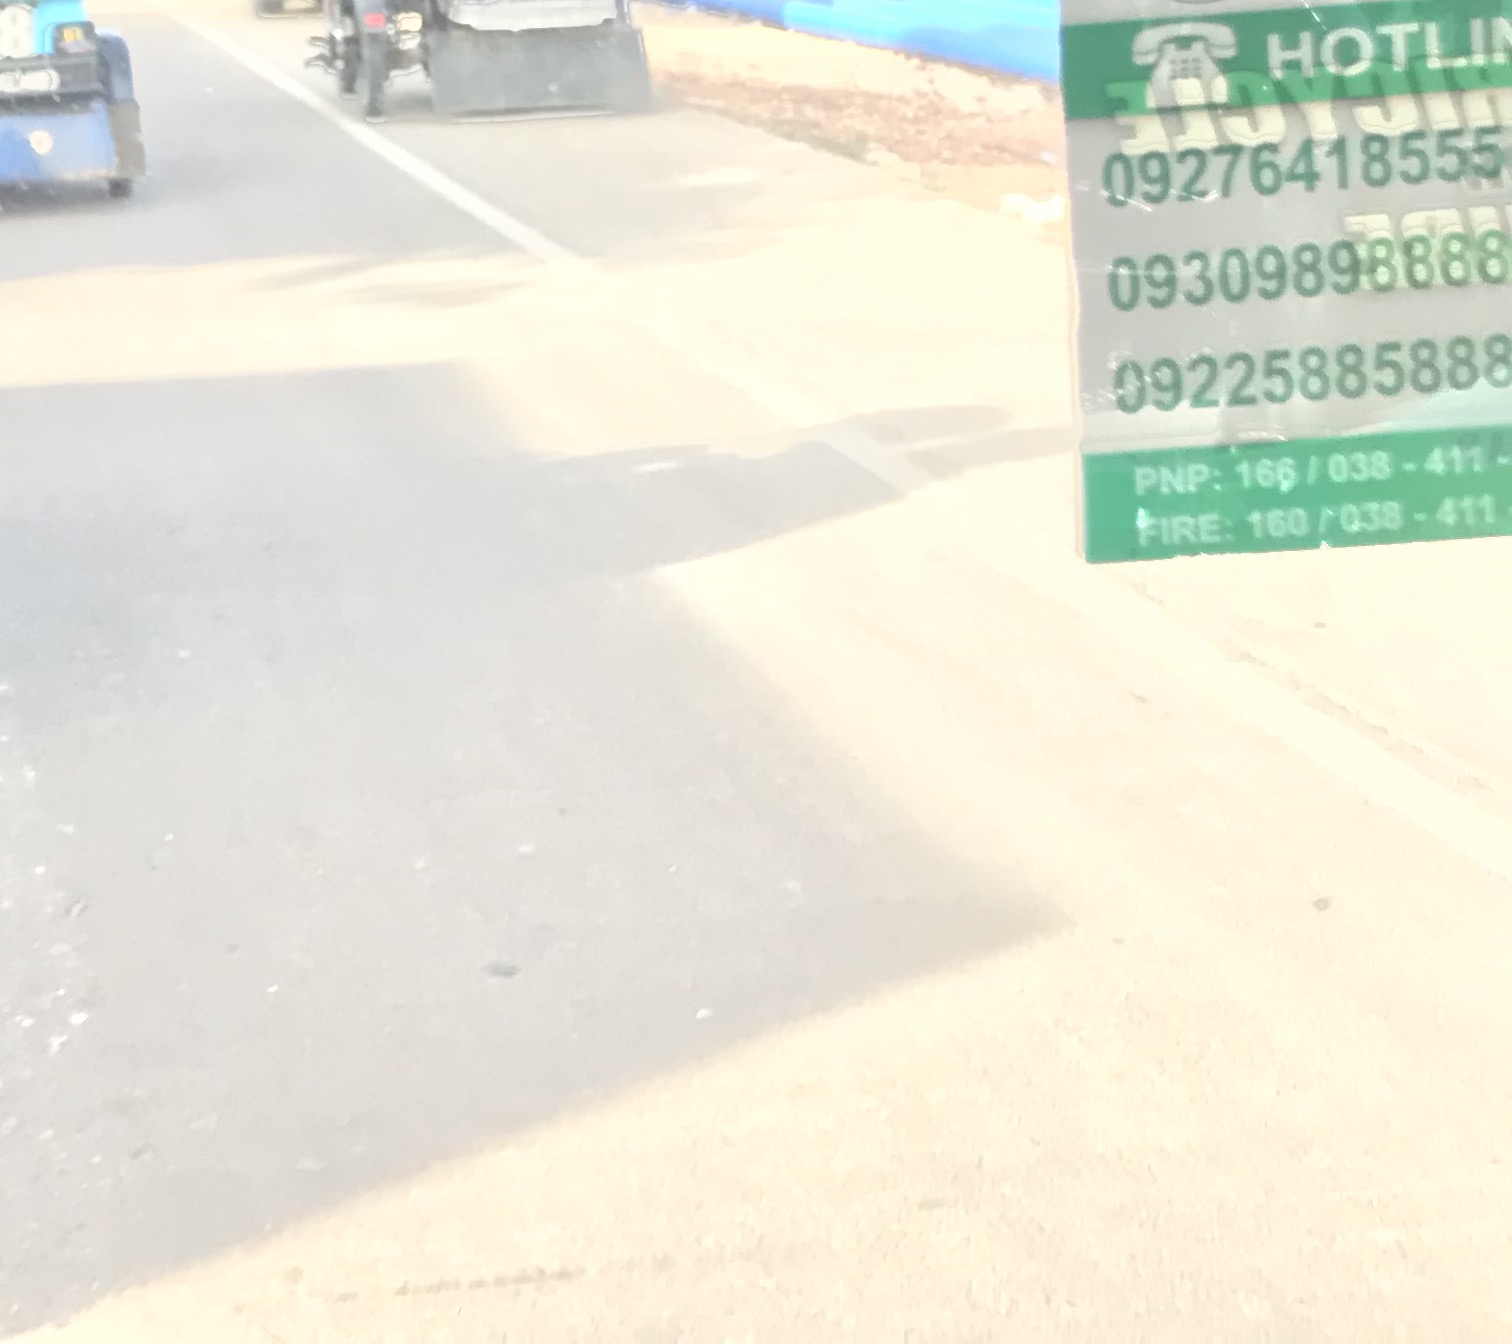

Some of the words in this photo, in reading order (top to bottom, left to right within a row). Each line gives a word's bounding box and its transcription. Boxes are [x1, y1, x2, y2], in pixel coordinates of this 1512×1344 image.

[1101, 125, 1508, 207] 09276418555
[1108, 229, 1511, 313] 09309898888
[1113, 333, 1512, 415] 09225885888
[1136, 462, 1222, 495] PNP:
[1307, 454, 1318, 486] /
[1326, 449, 1392, 484] 038
[1423, 445, 1486, 478] 411
[1138, 510, 1234, 547] FIRE:
[1248, 506, 1310, 539] 160
[1339, 499, 1405, 534] 038
[1435, 493, 1496, 527] 411
